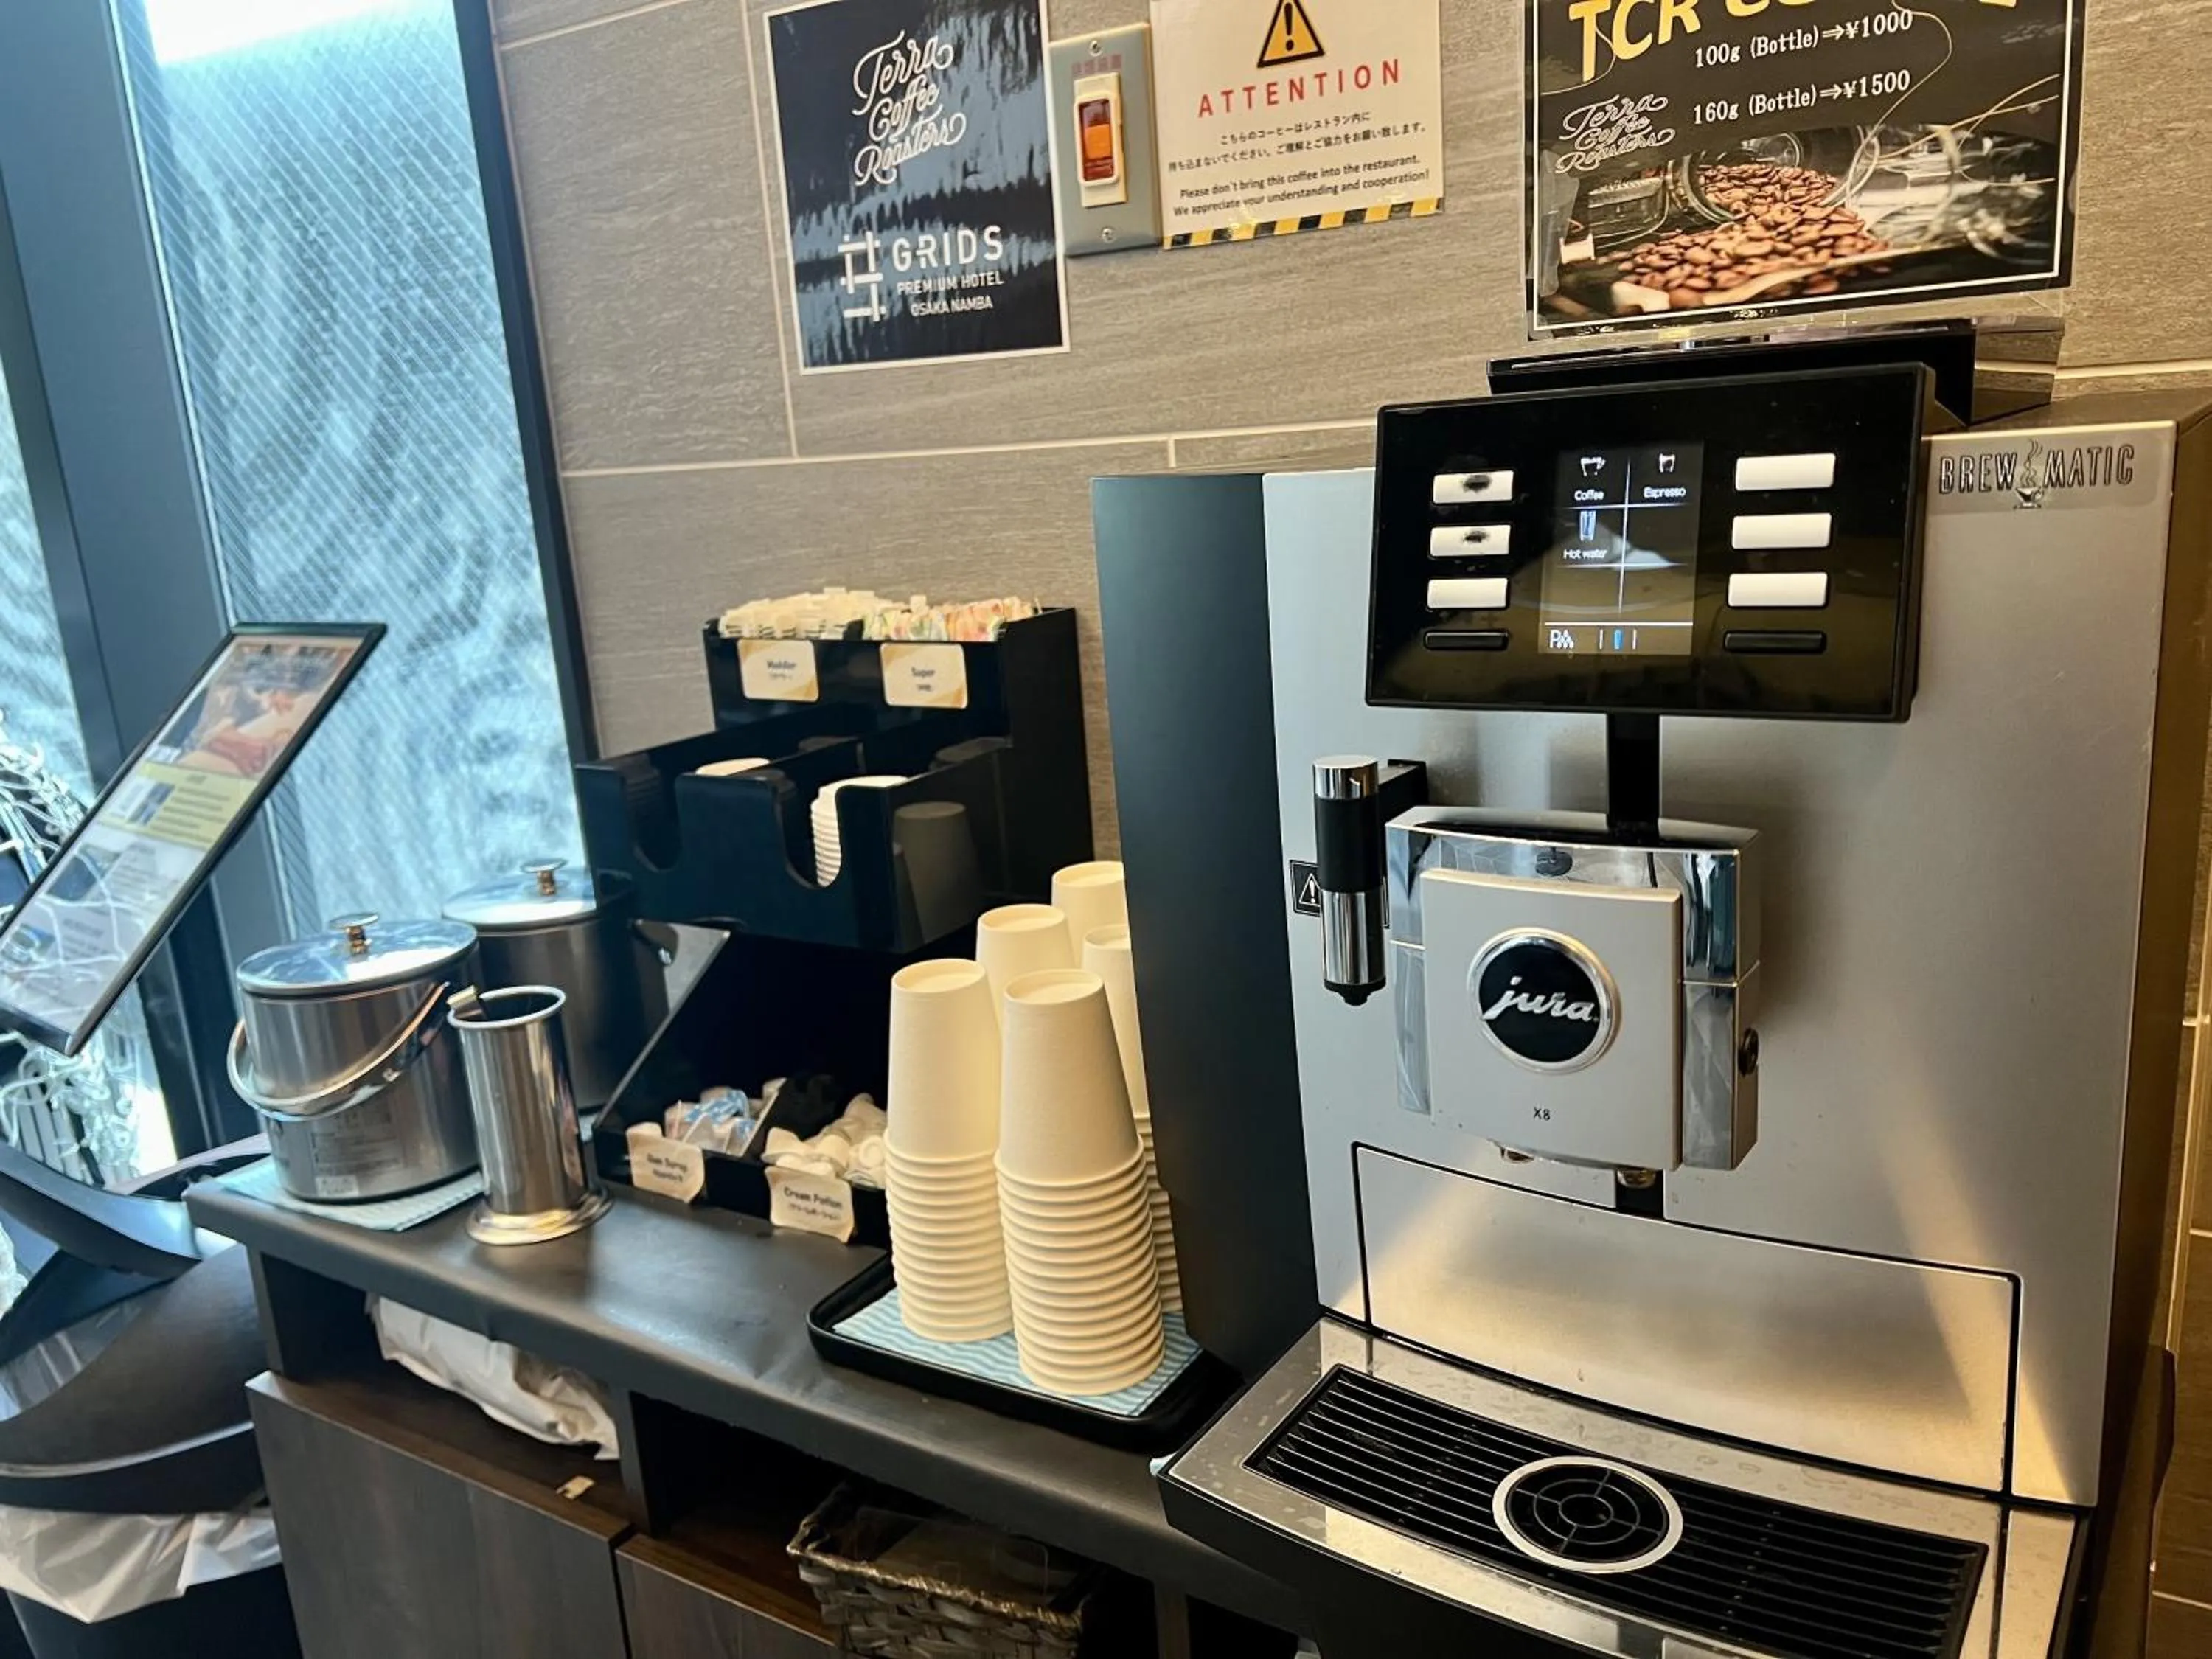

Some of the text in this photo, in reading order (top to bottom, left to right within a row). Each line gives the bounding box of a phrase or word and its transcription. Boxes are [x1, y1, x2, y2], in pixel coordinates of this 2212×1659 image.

[852, 29, 953, 116] Terra
[1695, 44, 1740, 68] 100g
[1197, 59, 1399, 118] ATTENTION
[868, 74, 940, 142] Coffee
[1559, 94, 1669, 140] Terra
[1693, 101, 1739, 125] 160g
[854, 104, 967, 187] Roasters
[1173, 206, 1189, 216] We
[1192, 199, 1241, 215] appreciate
[1242, 195, 1265, 207] your
[1267, 184, 1339, 203] understanding
[1340, 178, 1360, 192] and
[1180, 187, 1210, 198] Please
[1239, 178, 1265, 190] bring
[1267, 174, 1285, 186] this
[1287, 170, 1318, 184] coffee
[1320, 167, 1341, 178] into
[1343, 163, 1360, 174] the
[891, 225, 1004, 273] GRIDS
[896, 270, 1005, 296] PREMIUM HOTEL
[909, 294, 994, 318] OSAKA NAMBA
[1939, 443, 2135, 495] BREW MATIC
[1573, 487, 1686, 501] Coffee Espresso
[1562, 548, 1608, 560] Hot water
[1482, 975, 1595, 1021] jura
[1532, 1106, 1551, 1121] X8
